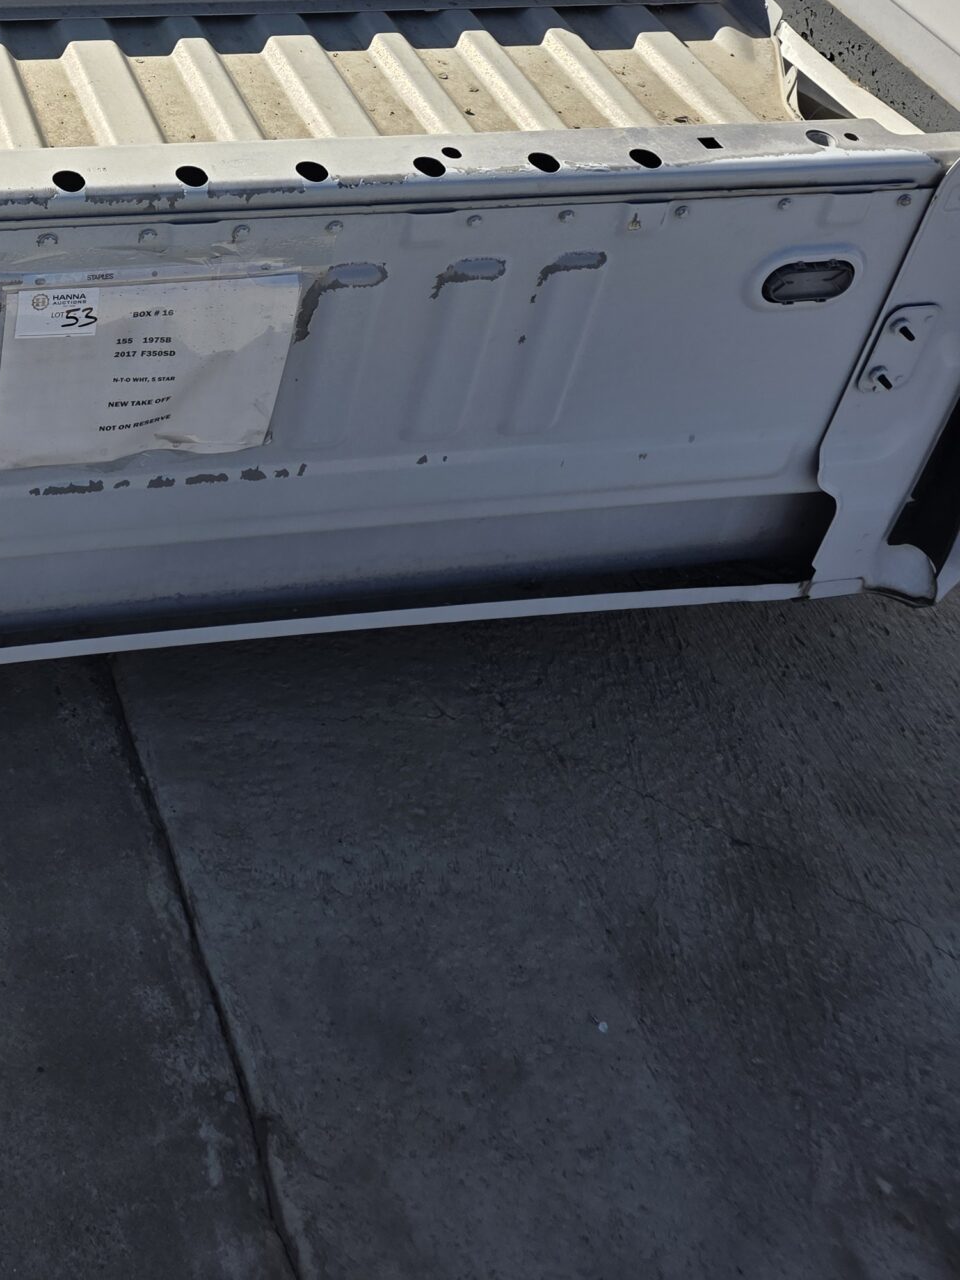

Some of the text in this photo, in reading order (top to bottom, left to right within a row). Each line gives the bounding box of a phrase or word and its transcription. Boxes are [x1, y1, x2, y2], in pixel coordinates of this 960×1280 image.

[87, 273, 114, 281] STAPLES
[52, 293, 86, 301] HANNA
[51, 311, 65, 319] LOT
[61, 307, 98, 327] 53
[113, 350, 137, 358] 2017
[130, 399, 153, 407] TAKE
[155, 396, 172, 404] OFF
[133, 414, 171, 428] RESERVE
